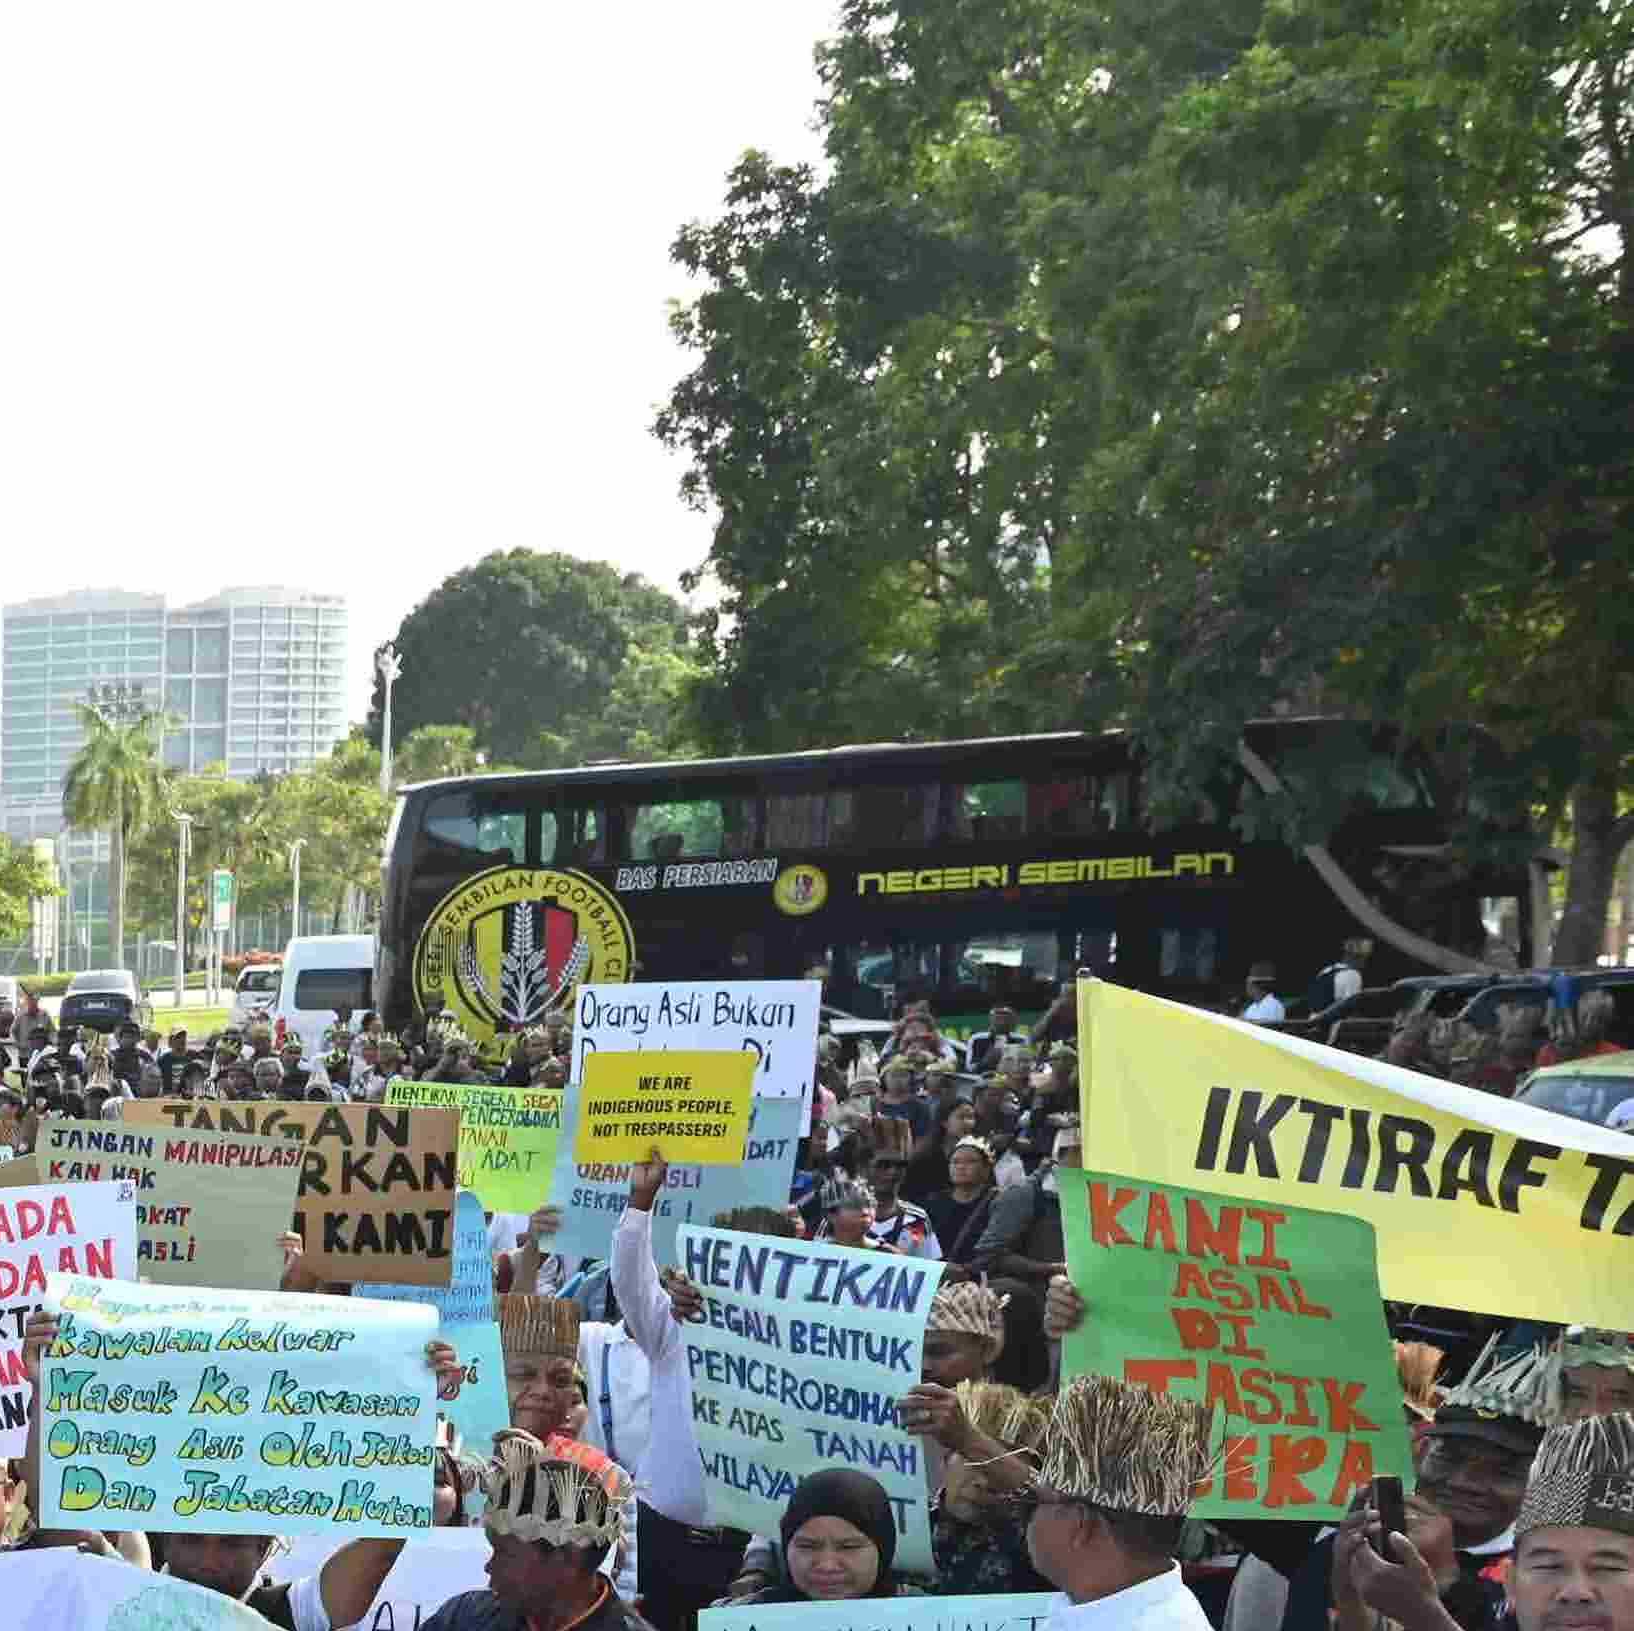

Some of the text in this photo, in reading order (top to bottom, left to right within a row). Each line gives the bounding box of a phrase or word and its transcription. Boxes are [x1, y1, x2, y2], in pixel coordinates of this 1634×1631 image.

[616, 860, 779, 890] BAS PERSIARAN
[856, 853, 1234, 895] NEGERI SEMBILAN
[580, 990, 796, 1034] Orang Asli Bukan
[588, 1100, 736, 1117] INDIGENOUS PEOPLE,
[639, 1076, 692, 1091] WE ARE
[51, 1128, 305, 1169] JANGAN MANIPULASI
[593, 1121, 727, 1138] NOT TRESPASSERS!
[1194, 1087, 1563, 1214] IKTIRAF
[49, 1160, 101, 1182] KAN
[482, 1150, 541, 1172] ADAT
[322, 1208, 453, 1257] KAMI
[1085, 1178, 1292, 1273] KAMI
[683, 1236, 927, 1314] HENTIKAN
[1171, 1261, 1333, 1320] ASAL
[788, 1319, 914, 1373] BENTUK
[1170, 1306, 1267, 1360] DI
[45, 1366, 179, 1416] Masuk
[262, 1369, 422, 1418] Kawasan
[1123, 1357, 1382, 1432] TASIK
[47, 1418, 353, 1469] Orang Asli Oleh
[691, 1392, 918, 1476] KE ATAS TANAH
[59, 1465, 334, 1517] Dan Jabatan
